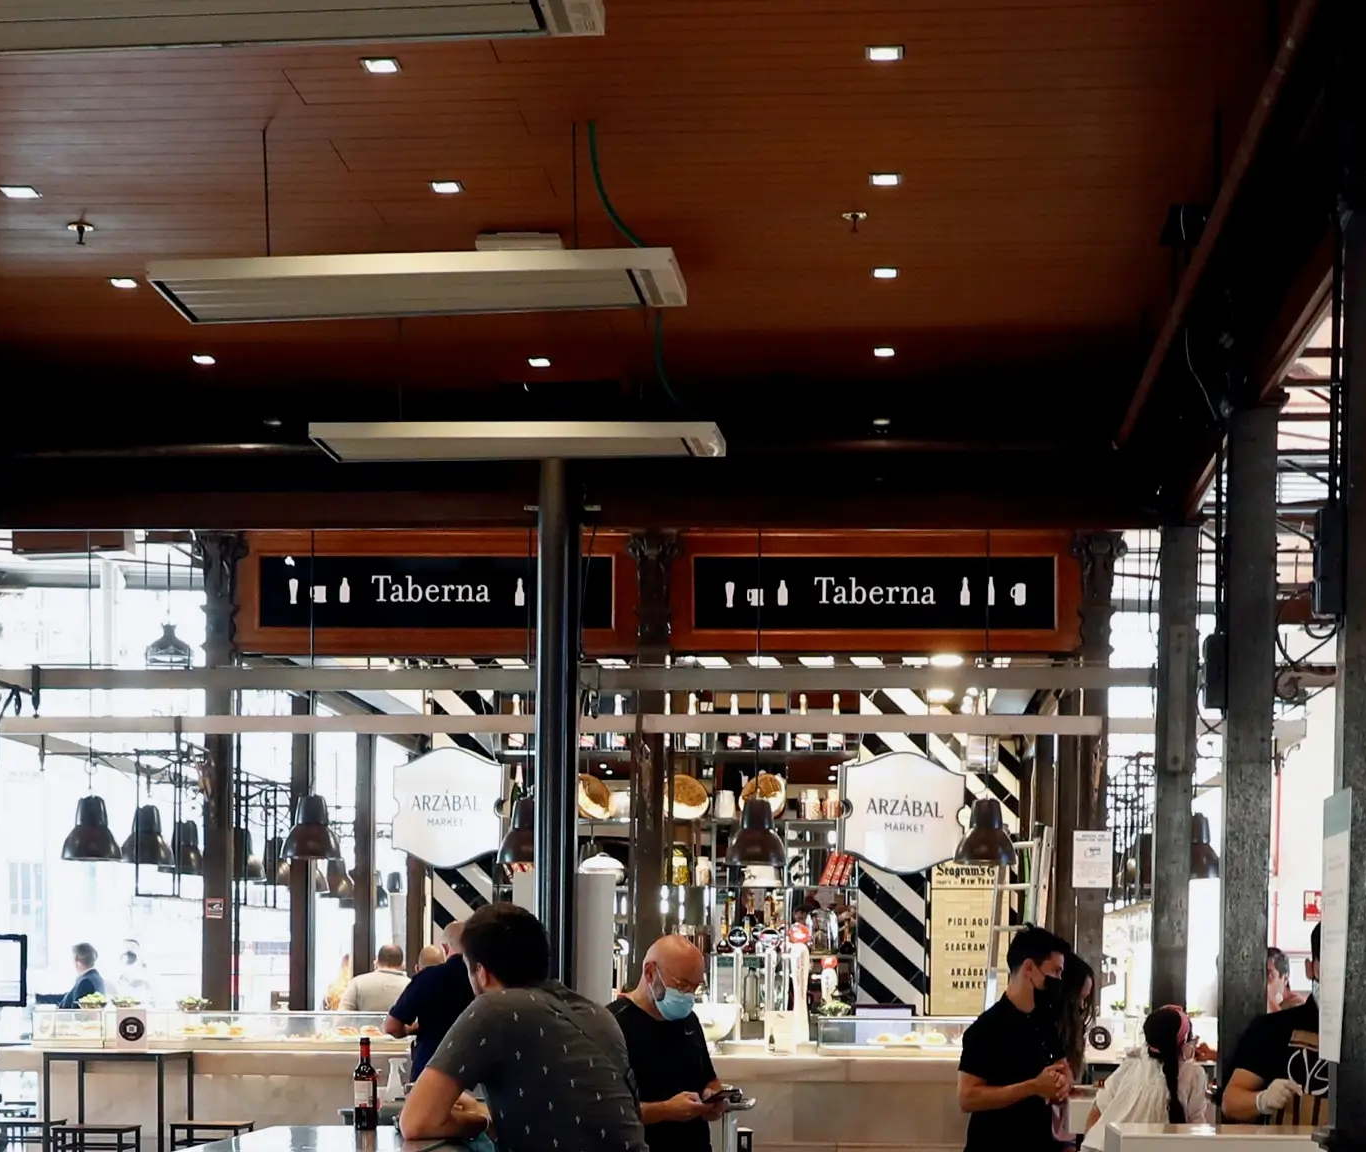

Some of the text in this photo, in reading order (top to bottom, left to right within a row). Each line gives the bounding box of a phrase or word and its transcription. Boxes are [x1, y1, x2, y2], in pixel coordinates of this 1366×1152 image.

[371, 575, 491, 603] Taberna
[814, 576, 936, 605] Taberna
[410, 789, 481, 812] ARZÁBAL
[866, 794, 944, 819] ARZÁBAL
[426, 817, 463, 827] MARKET
[884, 822, 925, 834] MARKET
[947, 917, 990, 928] PIDE AQU
[965, 930, 976, 939] TU
[945, 942, 989, 952] SEAGRAM'
